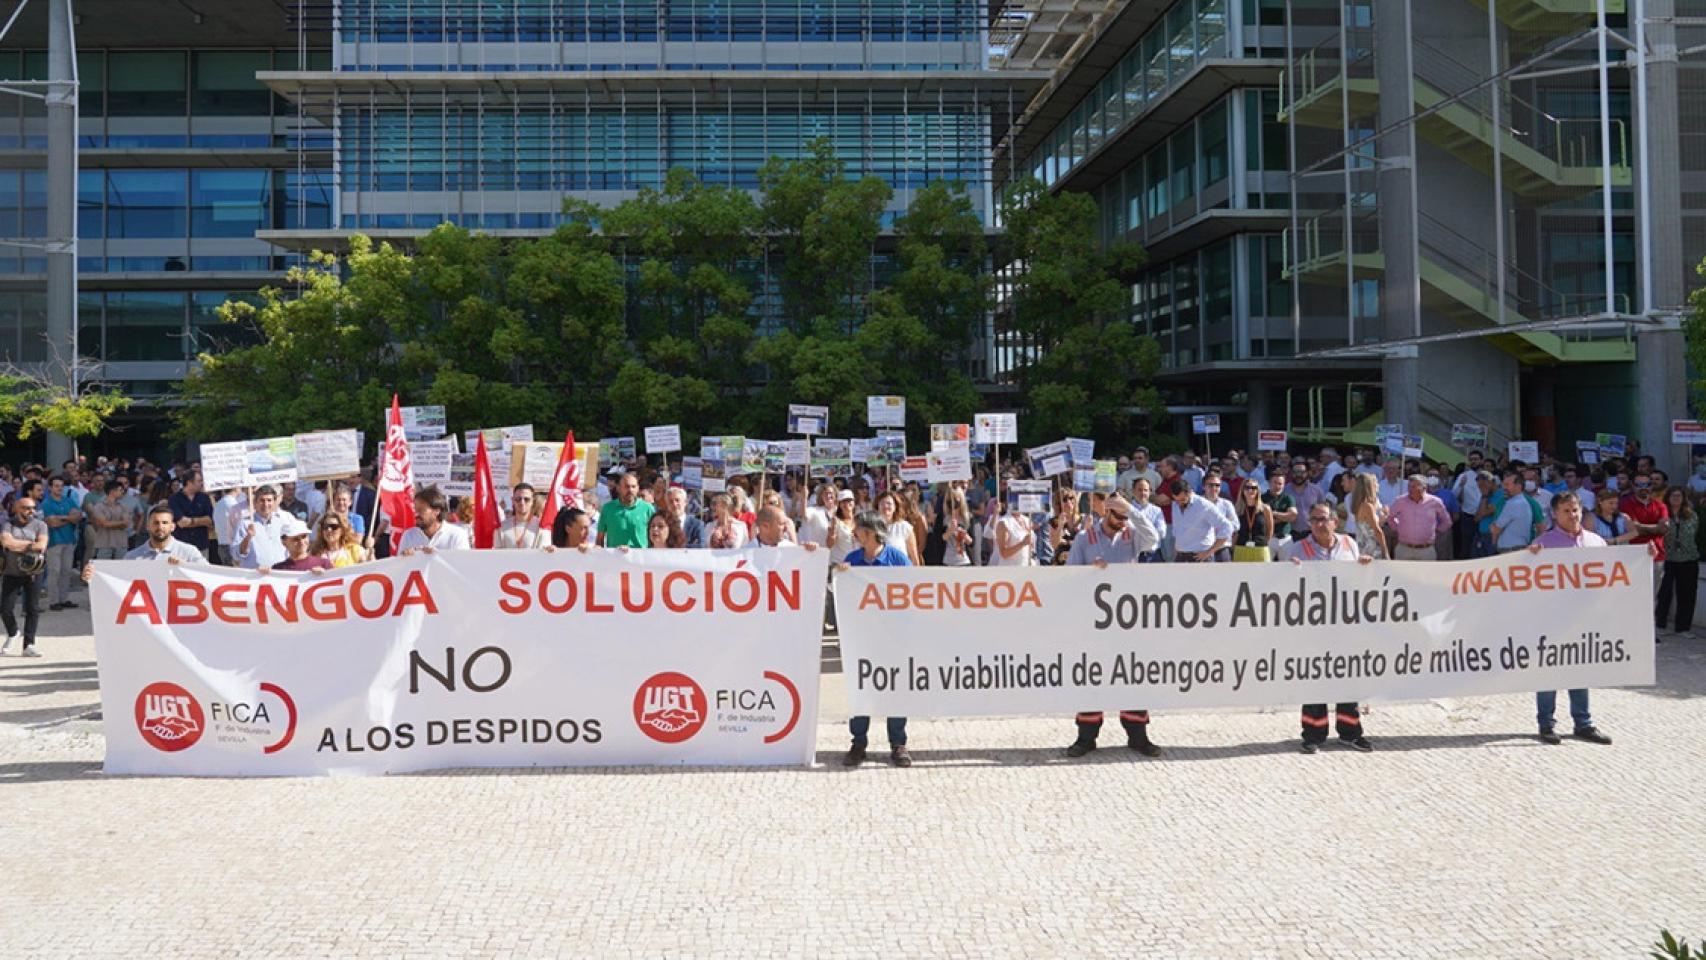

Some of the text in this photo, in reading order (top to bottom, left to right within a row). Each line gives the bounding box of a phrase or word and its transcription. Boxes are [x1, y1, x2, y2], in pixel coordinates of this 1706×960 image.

[116, 560, 801, 624] ABENGOA SOLUCIÓN
[1452, 561, 1631, 594] INABENSA
[859, 581, 1042, 610] ABENGOA
[1094, 576, 1418, 629] Somos Andalucía.
[409, 646, 512, 693] NO
[858, 632, 1631, 692] Por la viabilidad de Abengoa y el sustento de miles de familias.
[145, 695, 192, 719] UGT
[211, 702, 270, 723] FICA
[645, 686, 694, 711] UGT
[716, 690, 776, 710] FICA
[718, 725, 748, 733] SEVILLA
[740, 713, 776, 722] Industria
[317, 719, 602, 752] A LOS DESPIDOS
